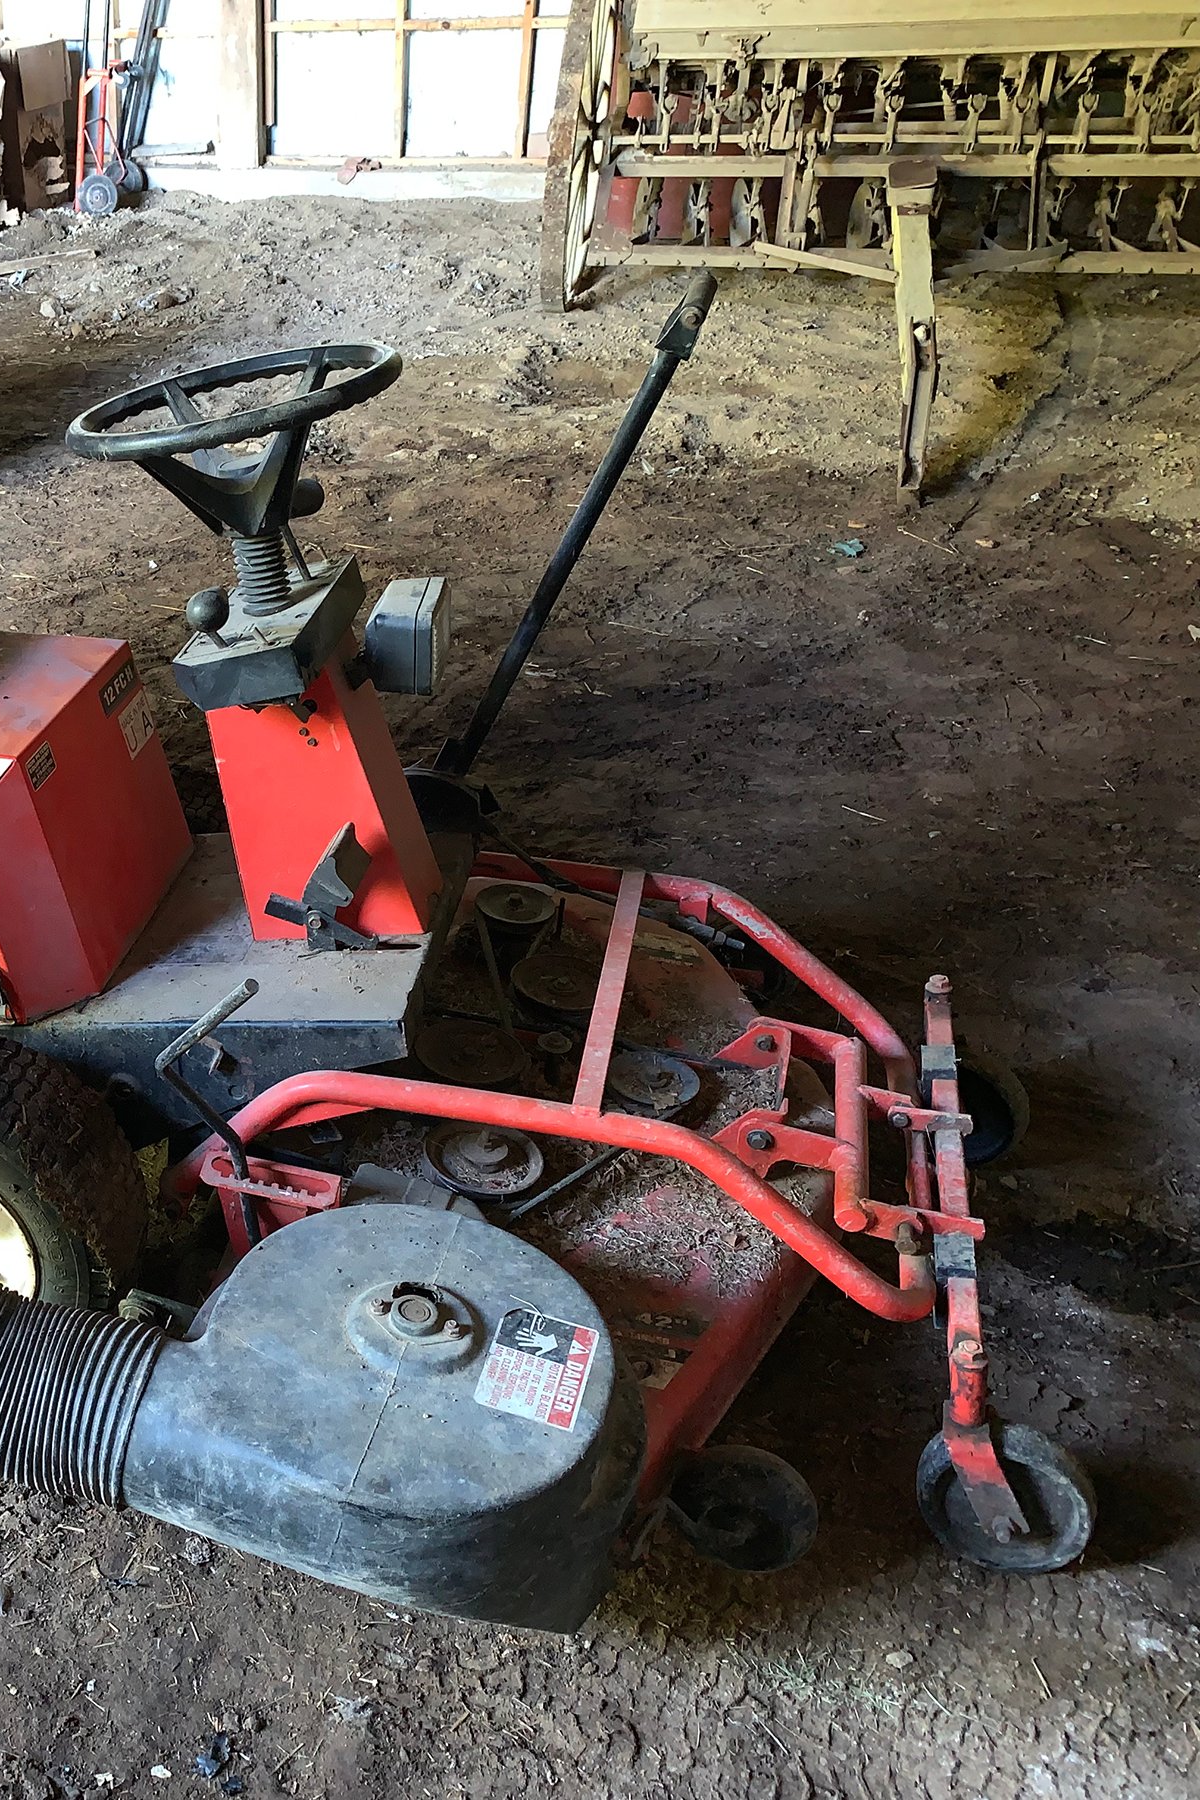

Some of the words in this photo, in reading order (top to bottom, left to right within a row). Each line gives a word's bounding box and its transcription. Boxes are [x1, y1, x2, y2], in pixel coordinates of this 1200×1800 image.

[104, 687, 116, 706] 12
[524, 1355, 535, 1367] AND
[516, 1368, 531, 1393] TRACTOR
[542, 1362, 560, 1394] ROTATING
[553, 1359, 584, 1413] DANGER
[523, 1384, 537, 1406] MOWER
[534, 1394, 551, 1419] BLADES
